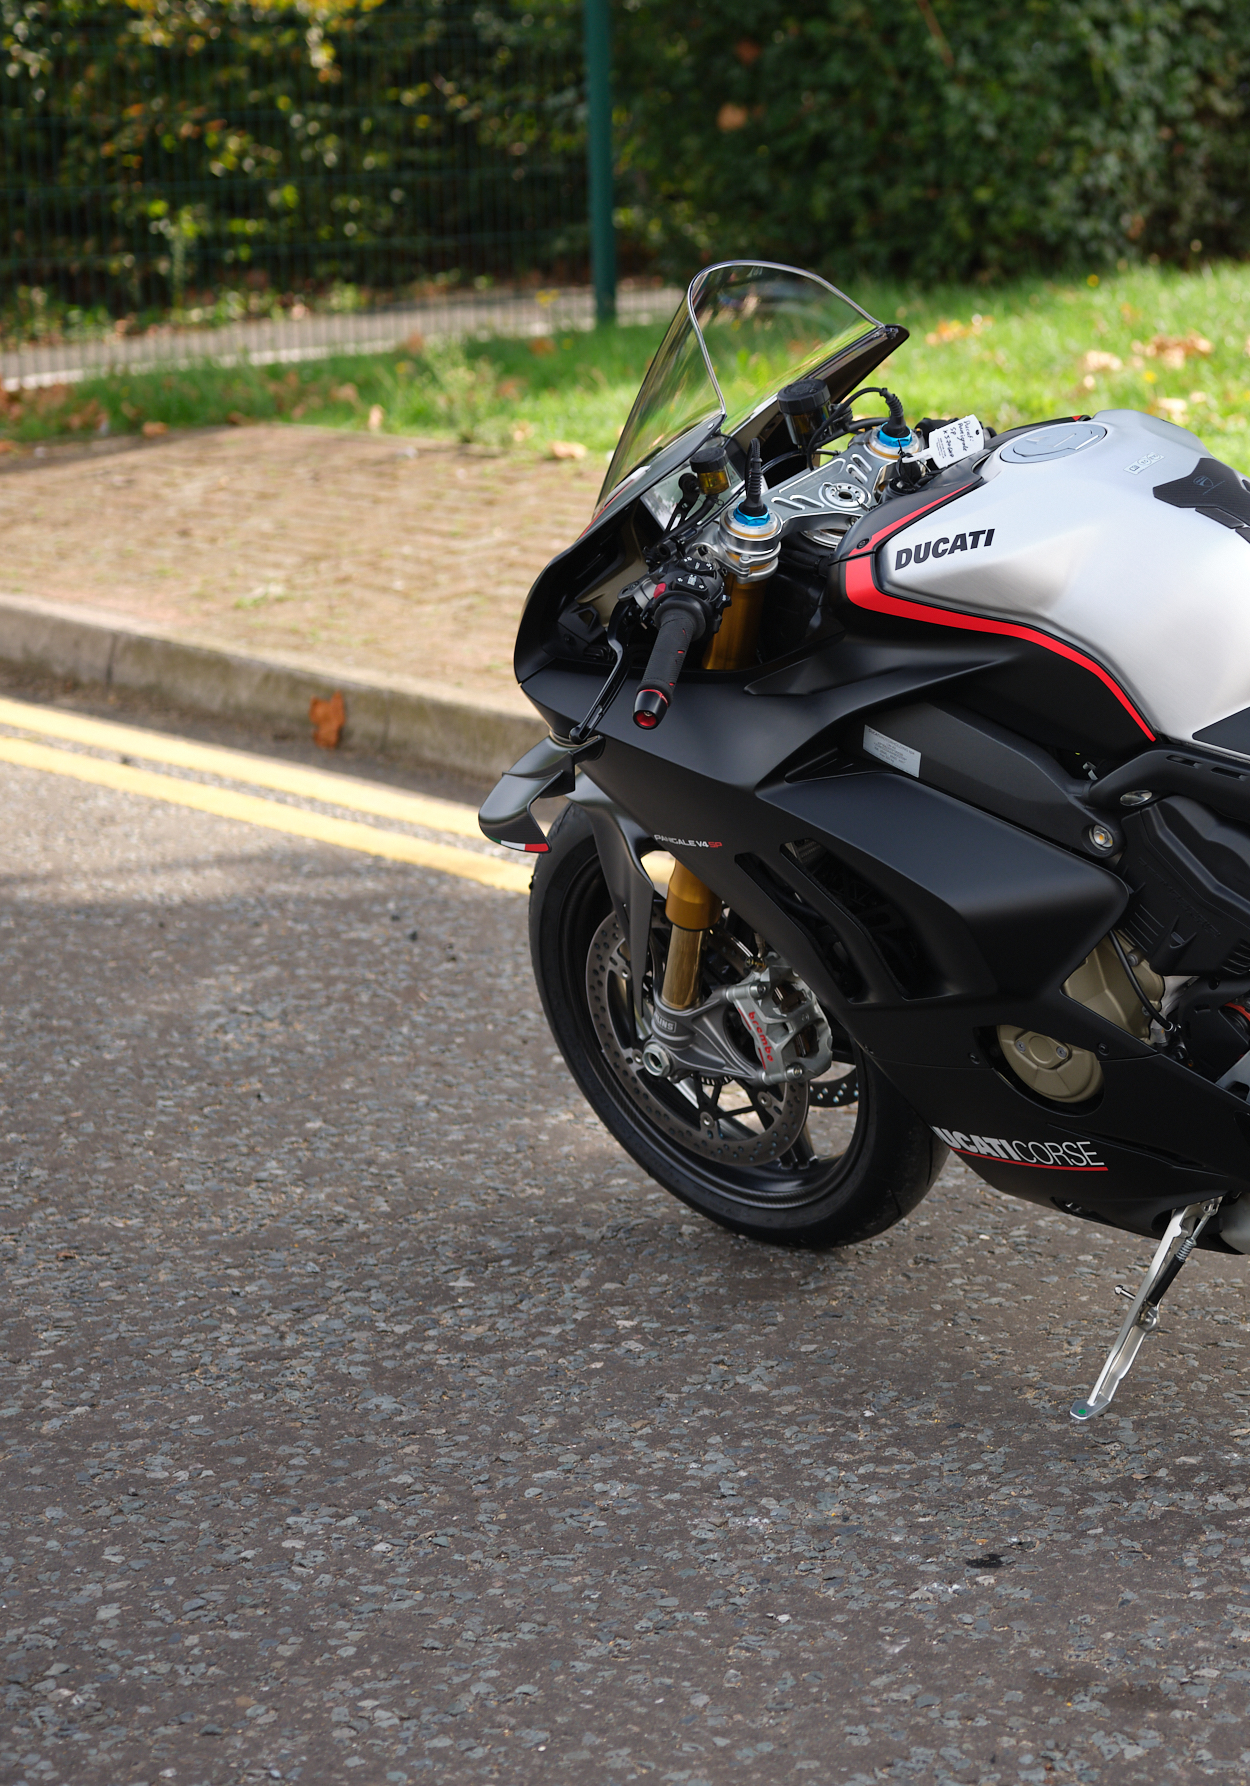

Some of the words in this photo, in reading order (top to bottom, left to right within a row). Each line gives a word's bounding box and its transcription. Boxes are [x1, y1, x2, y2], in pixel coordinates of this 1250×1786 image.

[895, 528, 995, 571] DUCATI
[654, 834, 697, 847] PANIGALE
[748, 1011, 774, 1062] brembo
[930, 1125, 1021, 1161] UCATI
